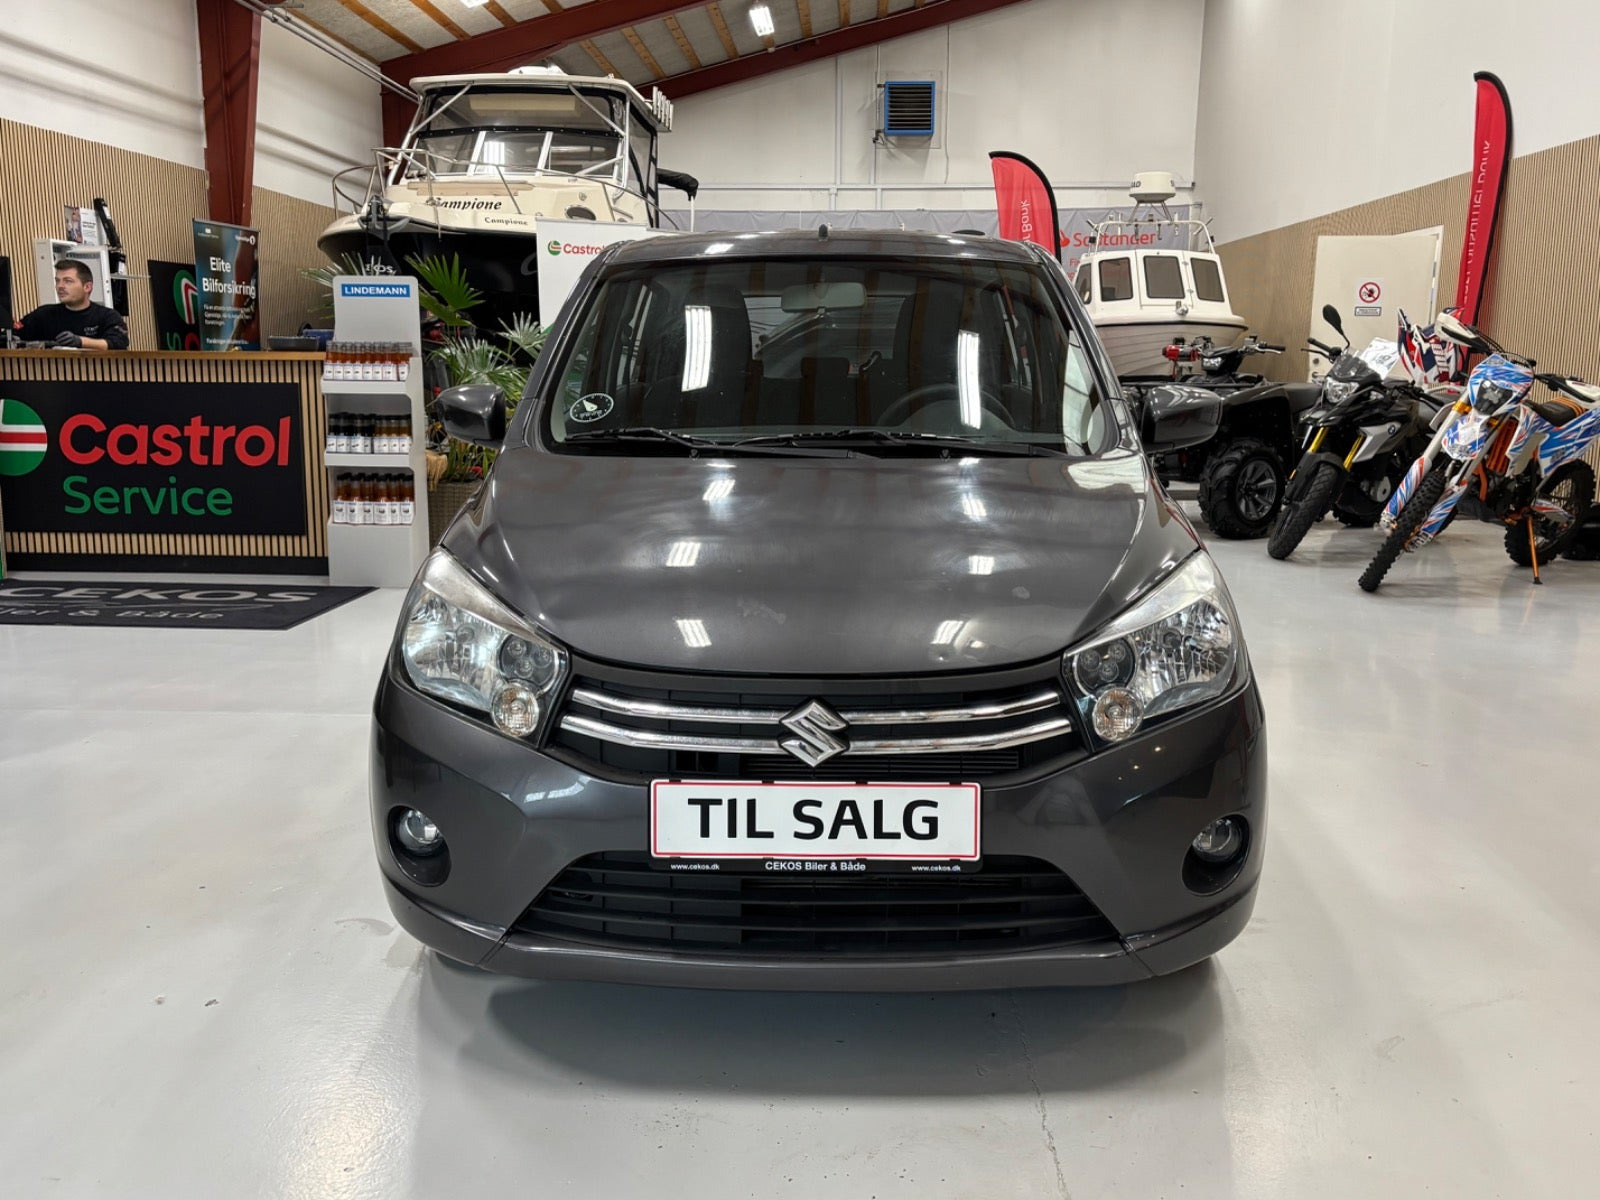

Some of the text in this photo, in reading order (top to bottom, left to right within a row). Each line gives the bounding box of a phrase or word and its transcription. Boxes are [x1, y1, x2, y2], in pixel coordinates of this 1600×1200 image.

[563, 243, 606, 255] Castro
[209, 256, 232, 273] Elite
[202, 277, 257, 300] Bilforsikring
[344, 286, 407, 296] LINDEMANN
[59, 413, 291, 467] Castrol
[63, 475, 233, 516] Service
[0, 586, 317, 602] CEKOS
[68, 609, 99, 617] &
[687, 798, 939, 840] TIL SALG
[670, 863, 720, 871] www.cekos.dk
[764, 860, 867, 871] CEKOS Biler & Både
[911, 864, 961, 872] www.cekos.dk
